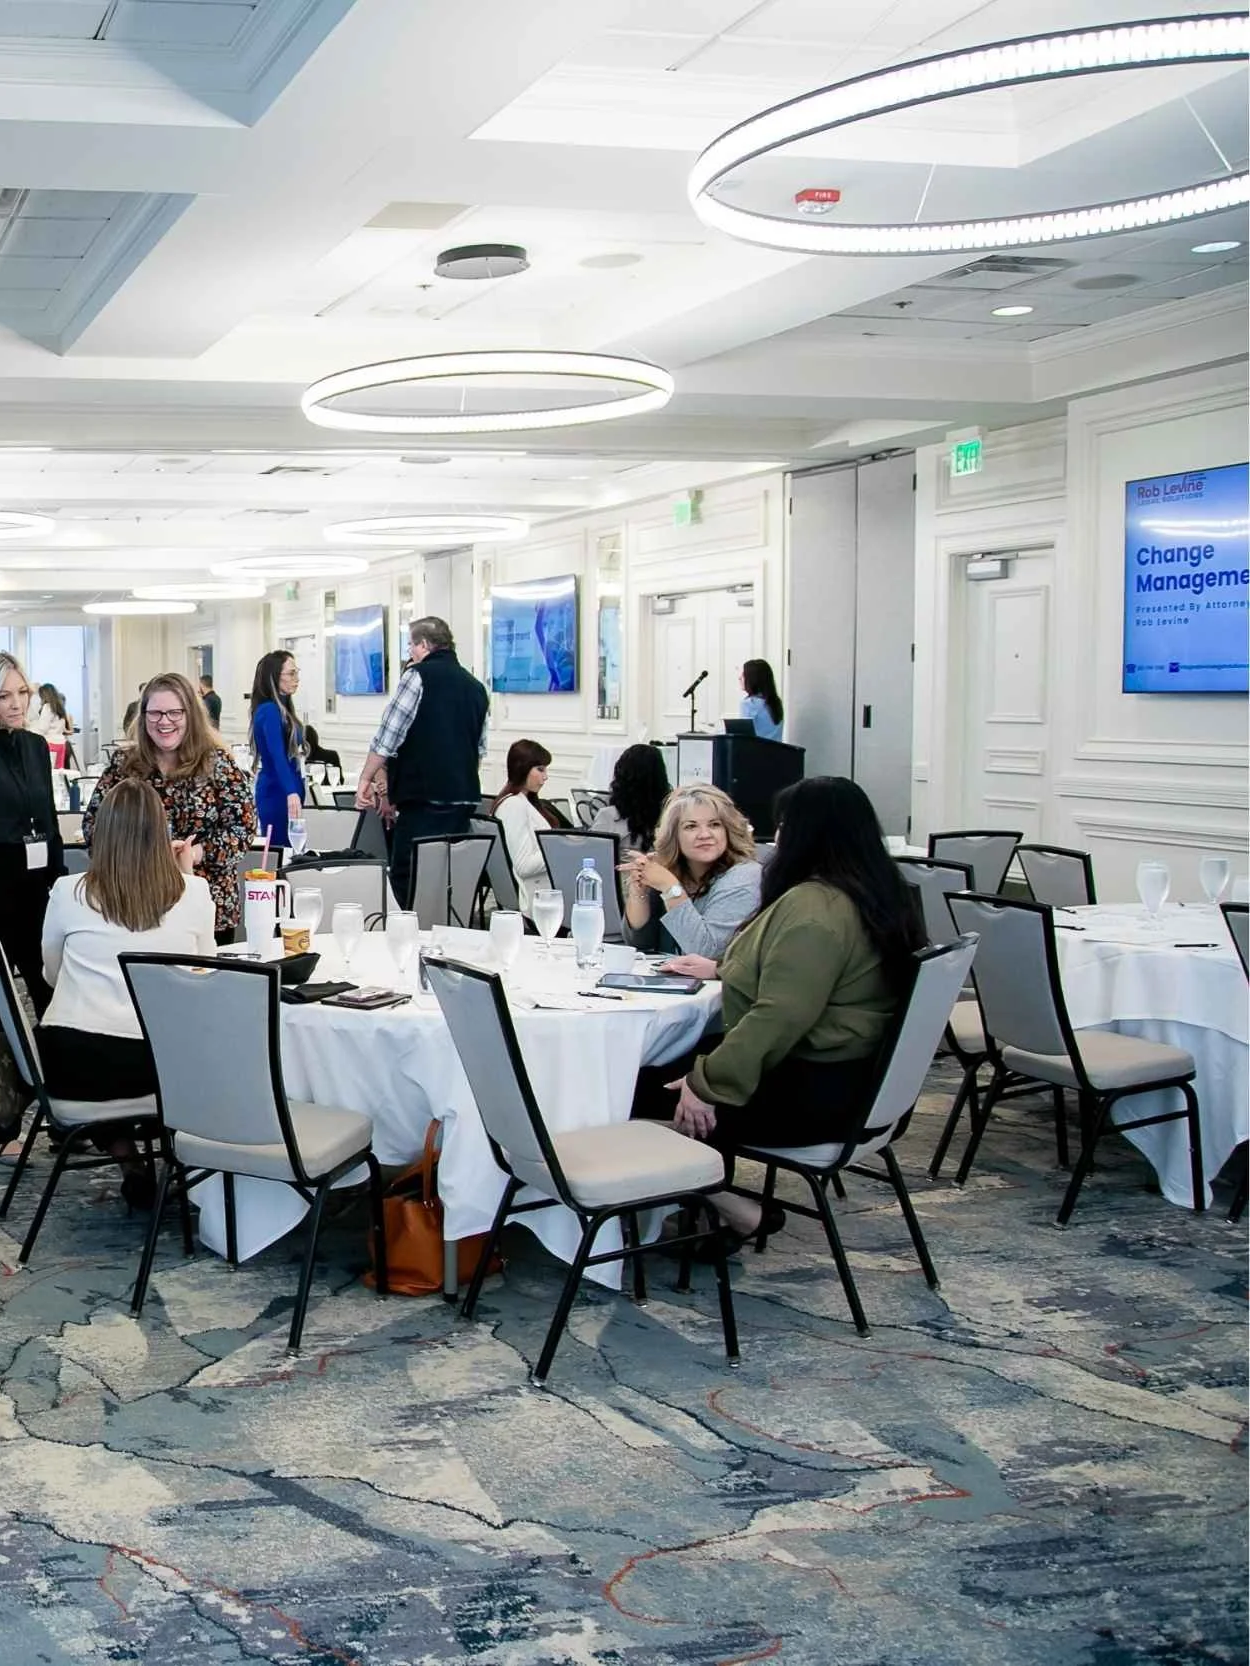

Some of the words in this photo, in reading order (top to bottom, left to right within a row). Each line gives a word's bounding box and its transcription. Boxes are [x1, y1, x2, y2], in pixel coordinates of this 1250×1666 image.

[956, 446, 979, 472] EXIT
[1137, 484, 1160, 499] Rob
[1163, 474, 1204, 495] Levine
[1136, 544, 1215, 567] Change
[1136, 568, 1249, 595] Manageme
[1157, 616, 1189, 626] Levine
